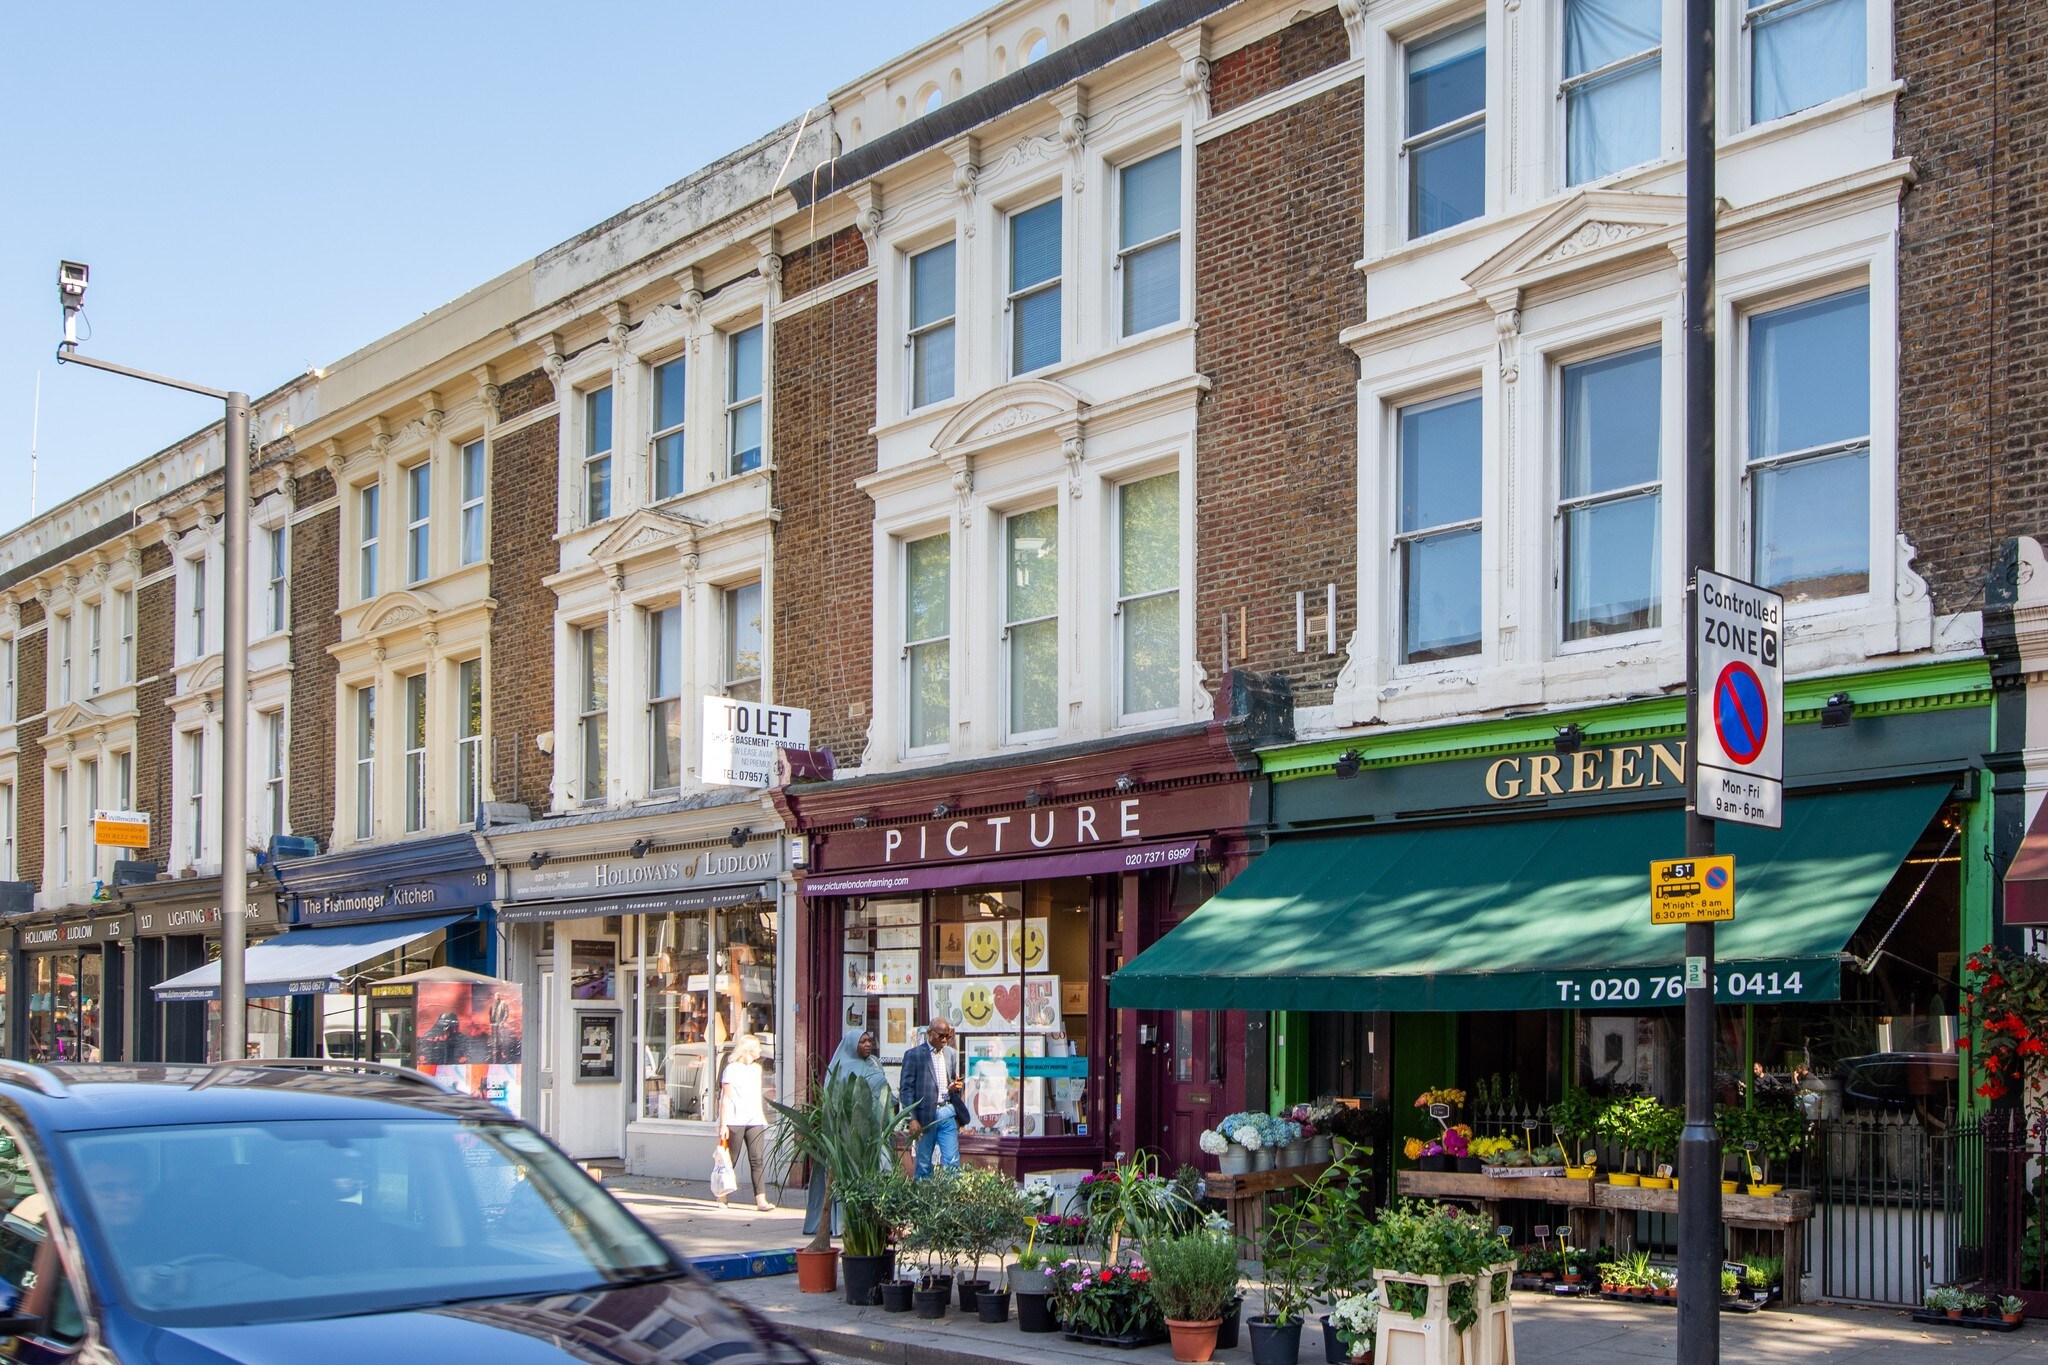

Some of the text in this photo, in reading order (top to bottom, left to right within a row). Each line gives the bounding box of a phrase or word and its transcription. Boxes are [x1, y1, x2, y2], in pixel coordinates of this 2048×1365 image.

[1703, 583, 1777, 625] Controlled
[1705, 616, 1776, 662] ZONE C
[724, 705, 792, 738] TO LET
[735, 735, 770, 748] BASEMENT
[741, 747, 758, 757] LEASE
[741, 758, 750, 766] NO
[723, 769, 738, 780] TEL:
[739, 770, 763, 783] 07957
[1722, 778, 1742, 795] Mon
[1748, 784, 1760, 799] Fri
[1716, 797, 1722, 811] 9
[1723, 801, 1737, 813] am
[1743, 802, 1750, 816] 6
[1751, 807, 1765, 819] pm
[885, 799, 1140, 862] PICTURE
[1125, 847, 1191, 866] 020 7371 6999
[594, 862, 679, 888] HOLLOWAYS
[682, 856, 701, 881] of
[704, 851, 772, 876] LUDLOW
[807, 876, 909, 892] www.picturelondonframing.com
[303, 899, 321, 914] The
[394, 887, 435, 906] Kitchen
[1701, 899, 1707, 907] 8
[141, 914, 152, 929] 117
[168, 909, 205, 926] LIGHTING
[1655, 911, 1676, 920] 6.30
[1677, 911, 1690, 920] pm
[25, 928, 58, 944] HOLLOWAYS
[67, 925, 93, 940] LUDLOW
[109, 921, 120, 936] 115
[1556, 980, 1580, 1001] T:
[1590, 978, 1641, 1001] 020
[1728, 971, 1803, 996] 0414
